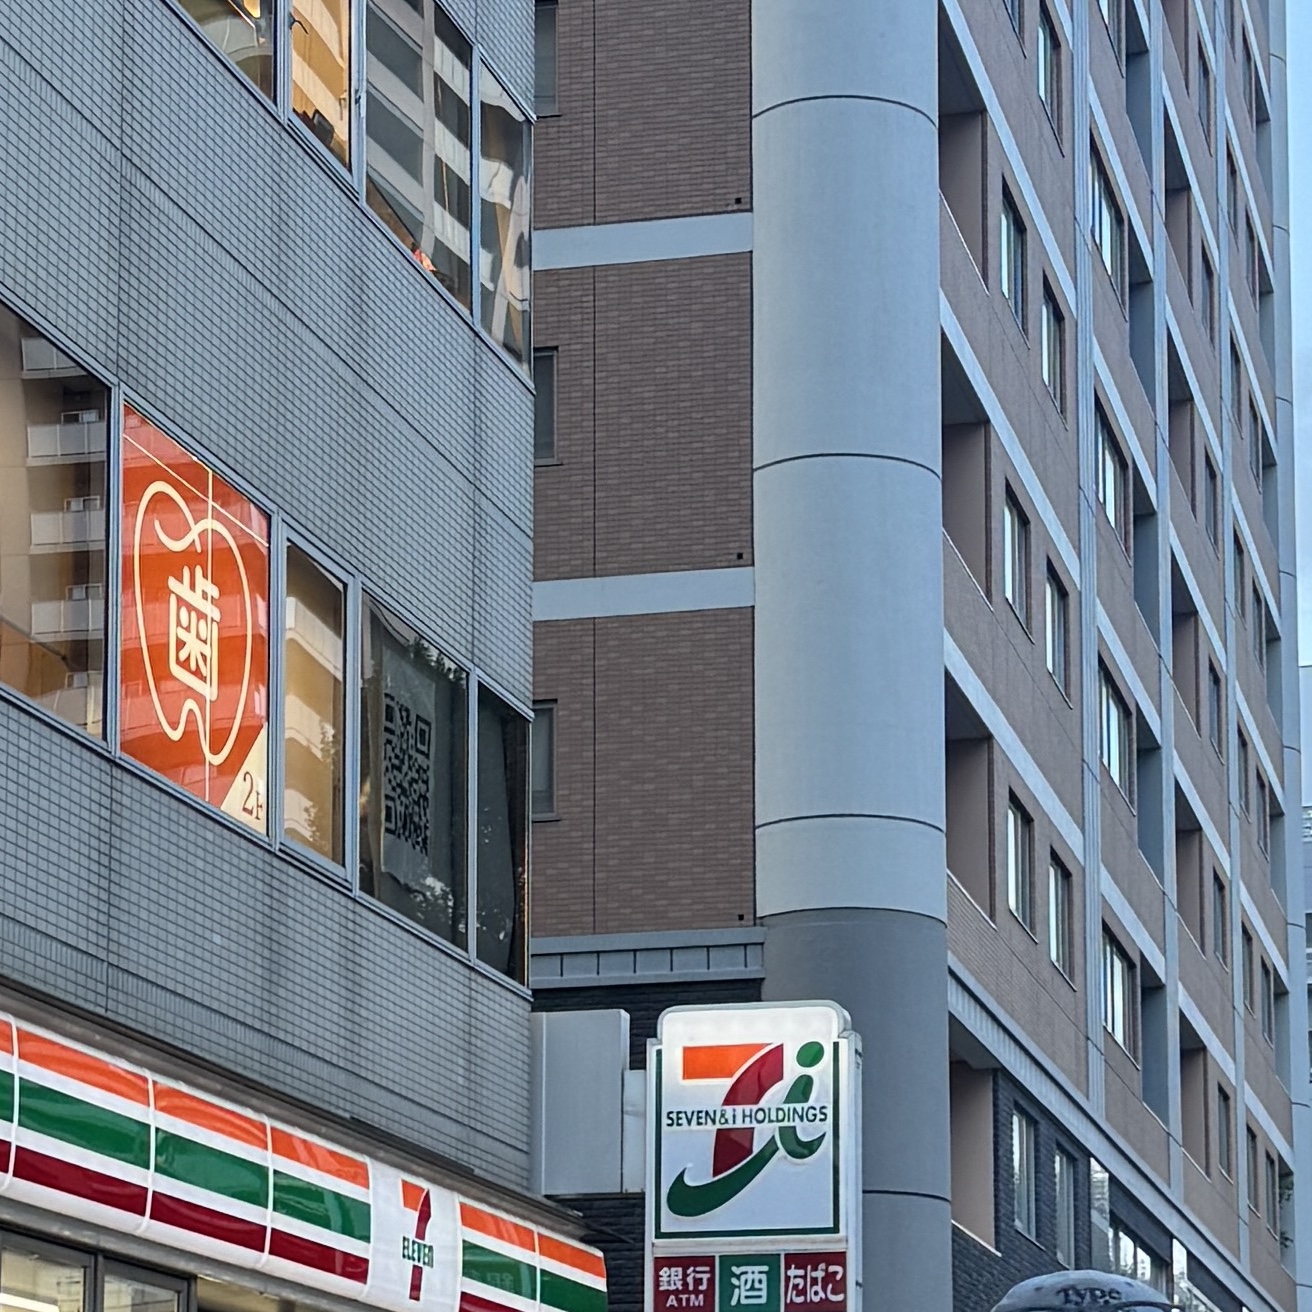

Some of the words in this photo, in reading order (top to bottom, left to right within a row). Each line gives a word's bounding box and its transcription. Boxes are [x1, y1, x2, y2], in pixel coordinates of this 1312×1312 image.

[167, 564, 221, 702] 歯
[742, 1105, 829, 1124] HOLDINGS
[658, 1265, 712, 1292] 銀行
[730, 1264, 770, 1307] 酒
[786, 1262, 846, 1305] たばこ
[666, 1293, 704, 1308] ATM
